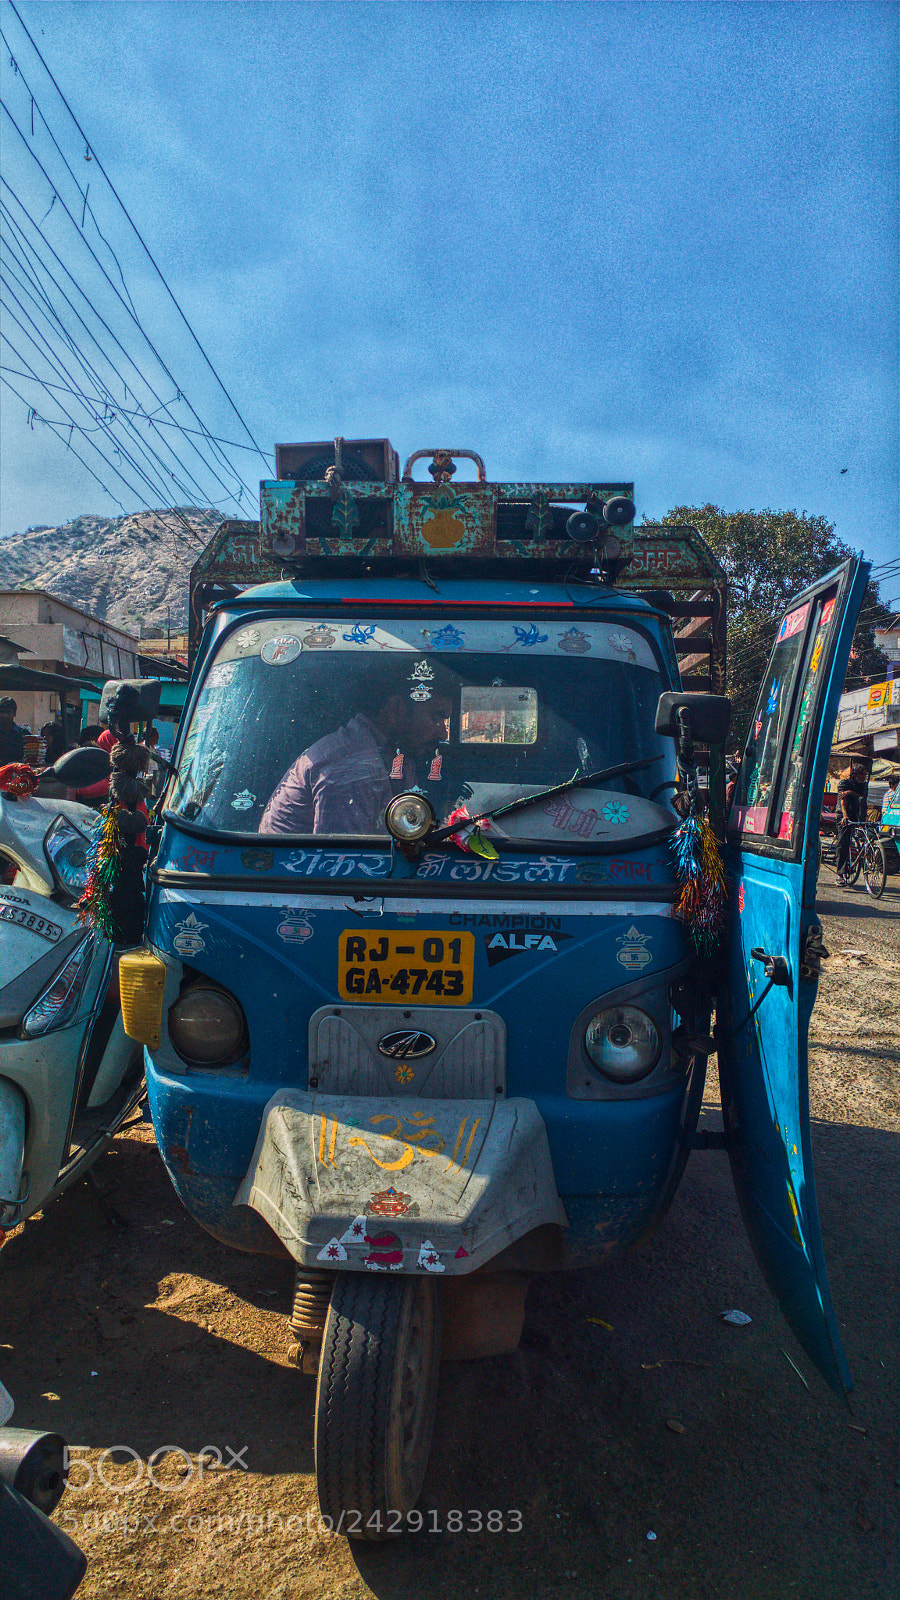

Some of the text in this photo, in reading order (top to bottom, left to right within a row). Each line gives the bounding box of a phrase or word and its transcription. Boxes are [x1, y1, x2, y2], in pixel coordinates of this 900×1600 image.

[448, 913, 562, 930] CHAMPION
[488, 933, 558, 951] ALFA
[345, 968, 464, 996] GA-4743
